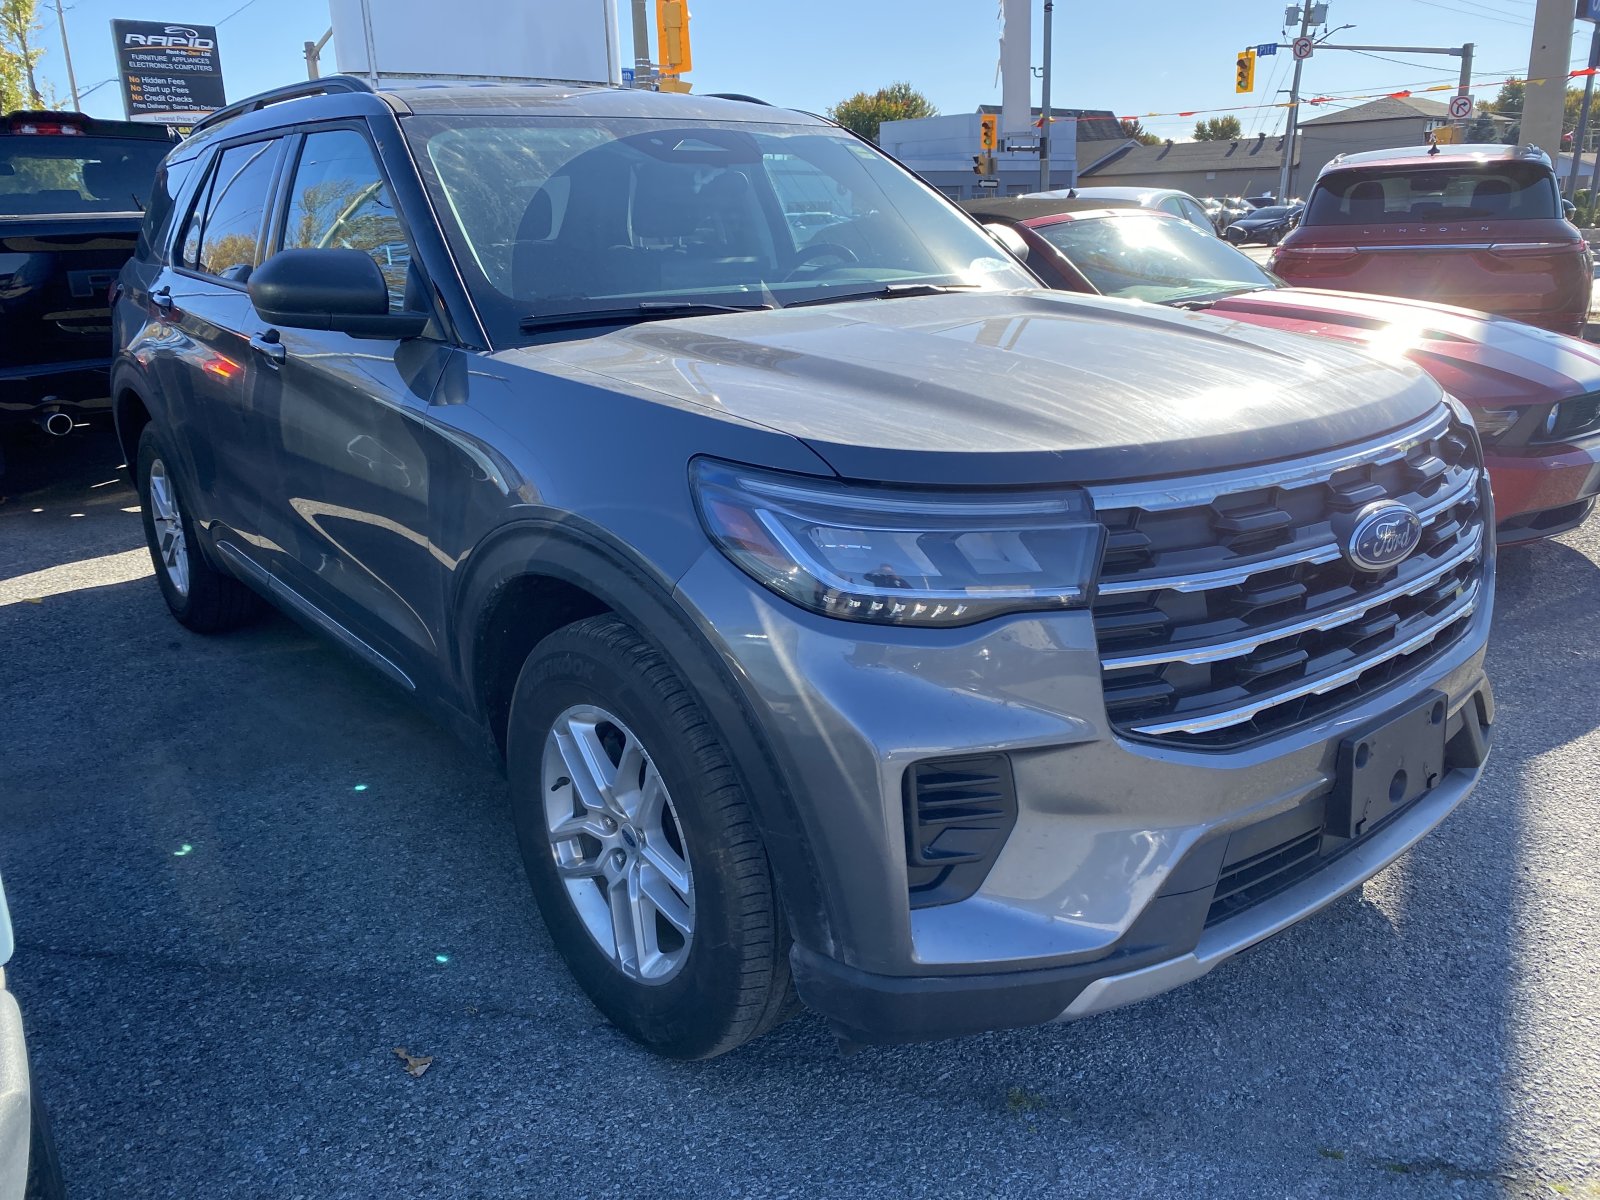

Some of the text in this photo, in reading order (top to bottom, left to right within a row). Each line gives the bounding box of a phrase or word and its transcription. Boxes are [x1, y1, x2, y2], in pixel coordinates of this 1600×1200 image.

[124, 33, 214, 49] RAPID
[1259, 45, 1274, 55] Pitt
[131, 54, 210, 65] FURNITURE APPLIANCES
[128, 61, 213, 72] ELECTRONICS COMPUTERS
[142, 85, 161, 93] Start
[161, 86, 171, 94] up
[171, 86, 190, 94] Fees
[144, 94, 166, 102] Credit
[166, 94, 193, 103] Checks
[1363, 226, 1489, 235] LINCOLN
[1373, 520, 1411, 557] Ford
